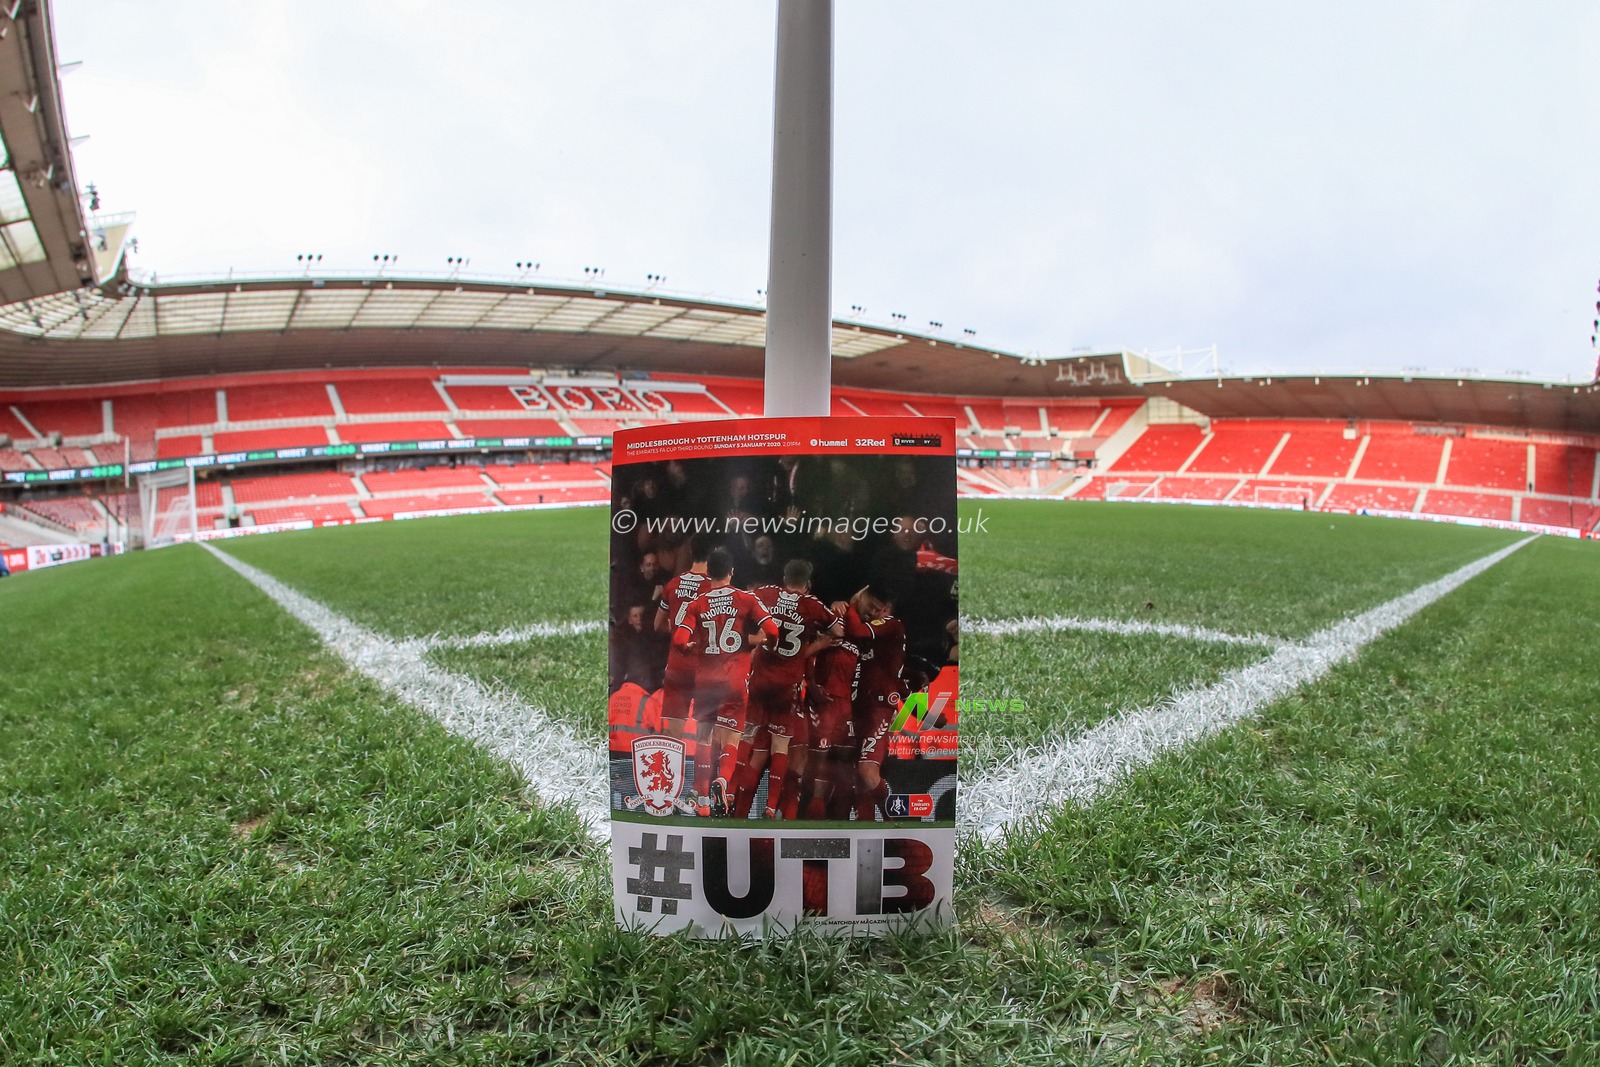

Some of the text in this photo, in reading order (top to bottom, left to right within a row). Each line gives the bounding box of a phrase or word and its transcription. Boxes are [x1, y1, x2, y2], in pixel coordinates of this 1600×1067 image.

[627, 438, 690, 449] MIDDLESBROUGH
[697, 435, 746, 443] TOTTENHAM
[706, 606, 738, 620] HOWSON
[770, 607, 804, 624] COULSON
[702, 618, 742, 654] 16
[636, 741, 682, 751] MIDDLESBROUGH
[626, 832, 936, 918] #UTB
